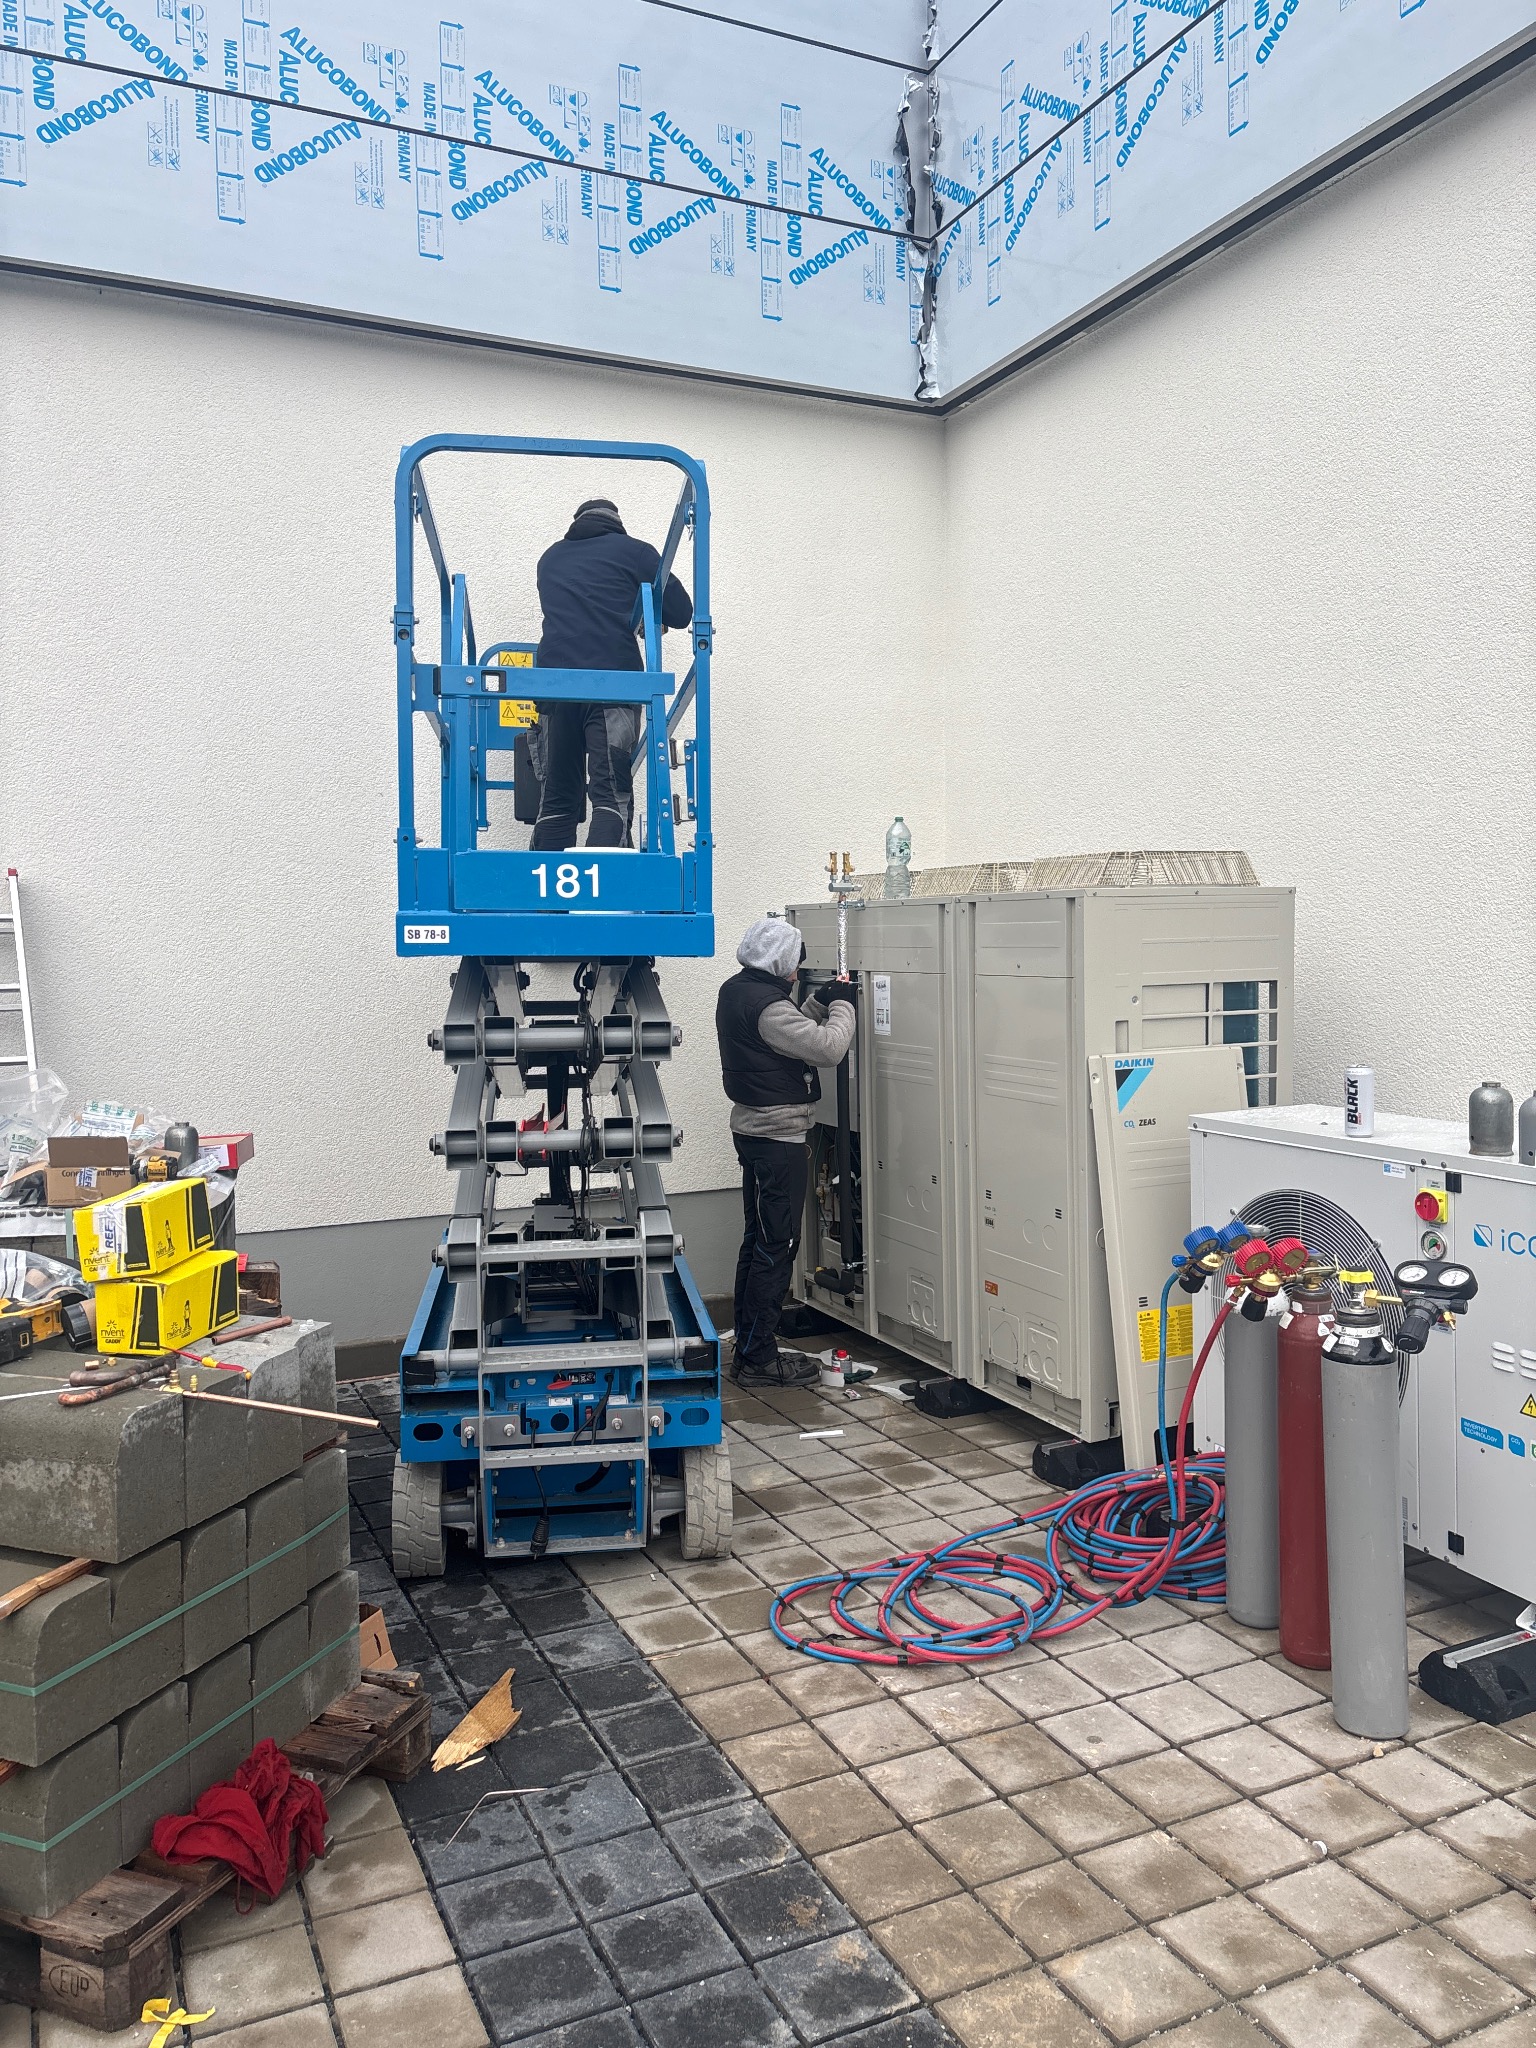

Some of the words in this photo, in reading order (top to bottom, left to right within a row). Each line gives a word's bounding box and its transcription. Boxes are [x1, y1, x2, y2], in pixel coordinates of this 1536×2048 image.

[224, 38, 238, 78] MADE
[279, 26, 391, 124] ALUCOBOND
[1100, 41, 1108, 86] MADE
[36, 79, 155, 143] ALUCOBOND
[423, 82, 436, 121] MADE
[473, 70, 575, 163] ALUCOBOND
[1019, 83, 1080, 122] ALUCOBOND
[1116, 36, 1188, 168] ALUCOBOND
[254, 120, 362, 183] ALUCOBOND
[603, 122, 615, 159] MADE
[649, 111, 741, 199] ALUCOBOND
[451, 161, 548, 221] ALUCOBOND
[767, 160, 777, 195] MADE
[809, 147, 892, 231] ALUCOBOND
[1005, 137, 1062, 251] ALUCOBOND
[629, 197, 717, 255] ALUCOBOND
[789, 229, 869, 286] ALUCOBOND
[531, 863, 599, 899] 181
[407, 930, 421, 940] SB
[424, 930, 447, 940] 78-8
[1115, 1058, 1154, 1069] DAIKIN
[1138, 1118, 1156, 1127] ZEAS
[1347, 1076, 1358, 1124] BLACK
[1463, 1421, 1488, 1434] INVERTER
[1464, 1427, 1497, 1443] TECHNOLOGY
